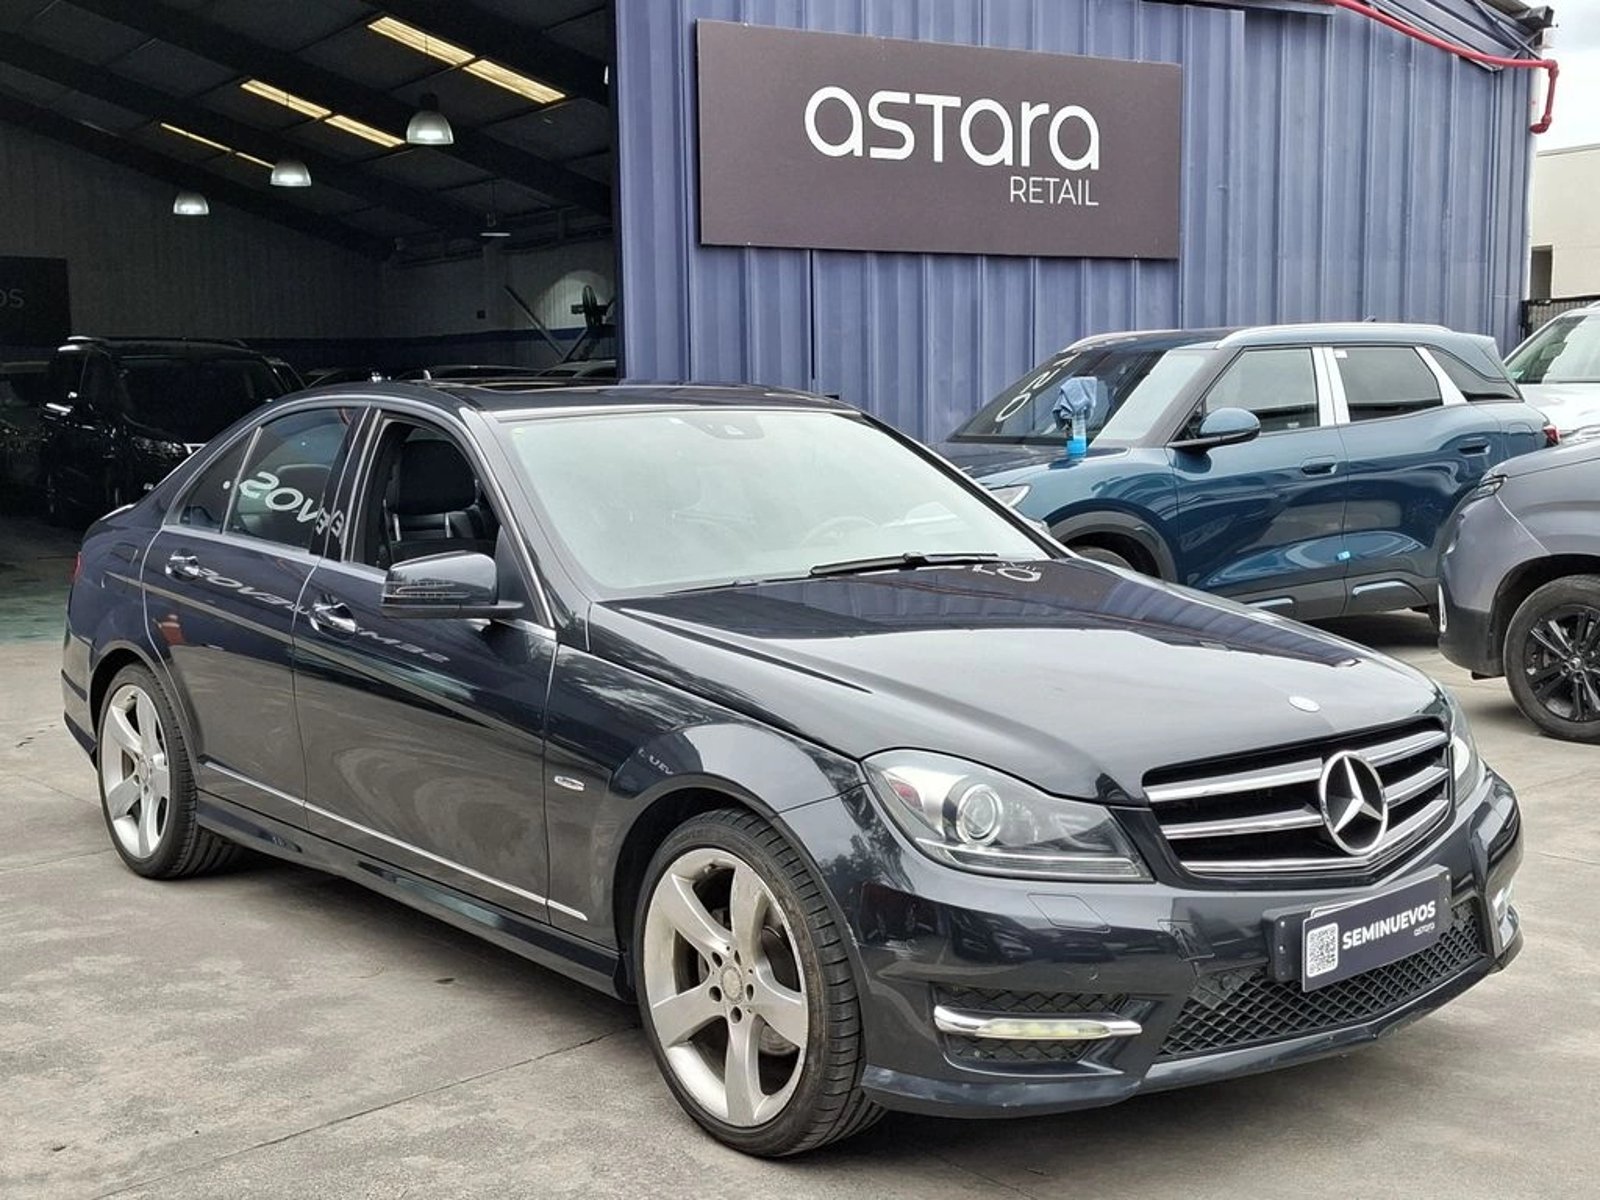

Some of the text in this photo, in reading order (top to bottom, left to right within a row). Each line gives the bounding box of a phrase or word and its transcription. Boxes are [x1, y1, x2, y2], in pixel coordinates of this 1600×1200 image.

[804, 85, 1099, 170] astara
[1009, 176, 1099, 206] RETAIL
[1342, 900, 1436, 950] SEMINUEVOS
